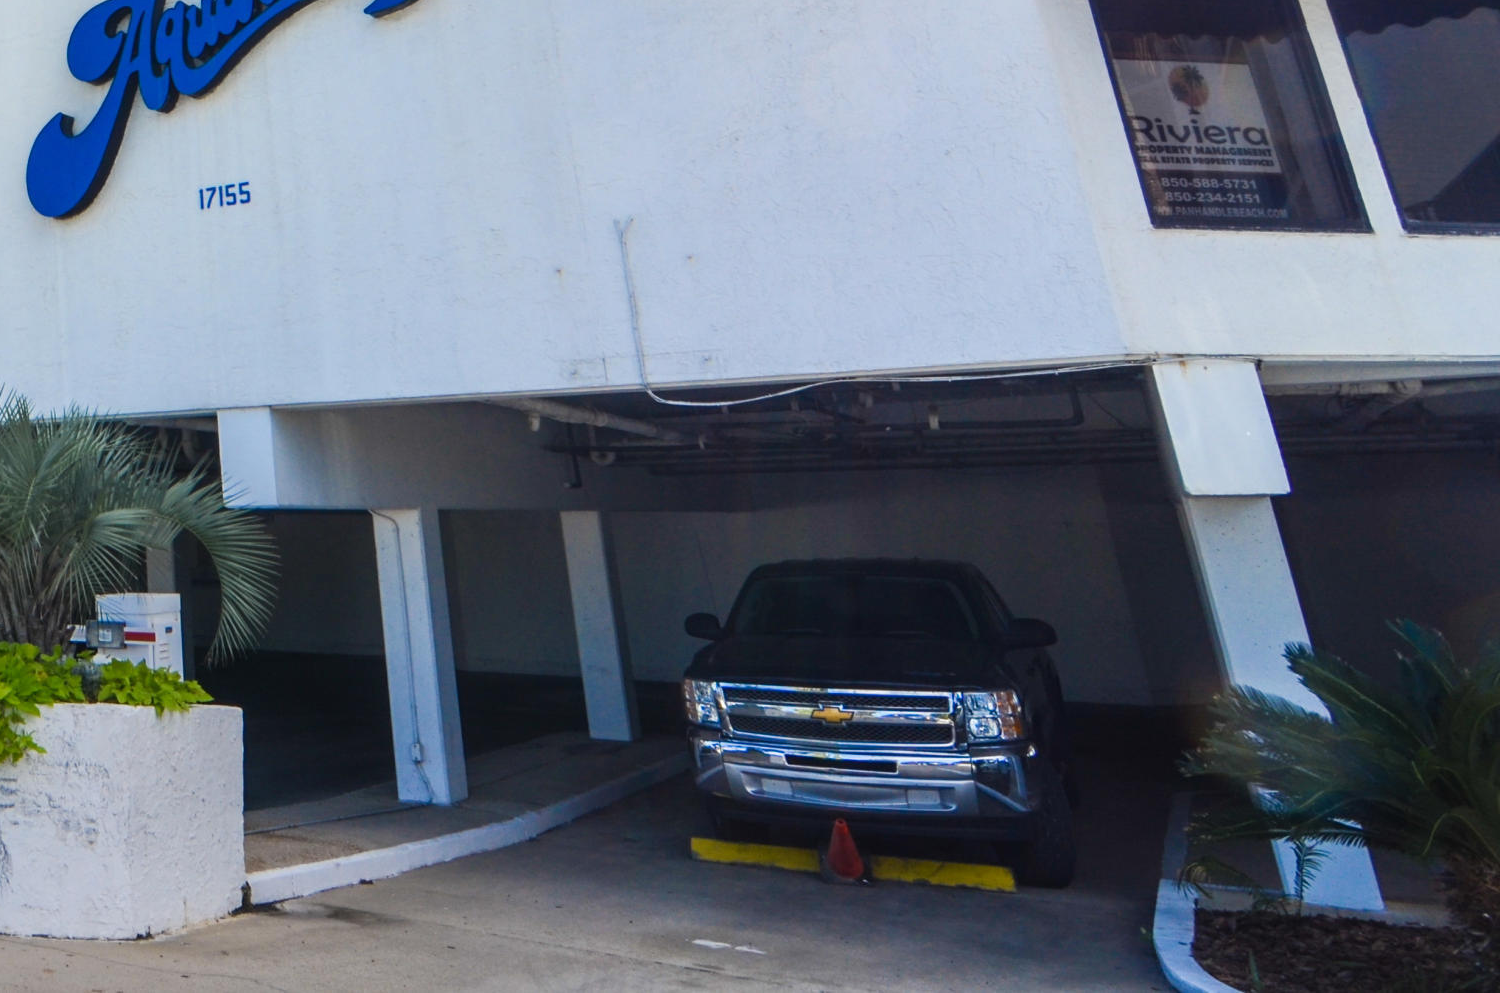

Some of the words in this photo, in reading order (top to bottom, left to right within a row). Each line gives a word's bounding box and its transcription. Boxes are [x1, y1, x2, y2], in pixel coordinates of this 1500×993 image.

[1131, 116, 1269, 146] Riviera
[1195, 147, 1272, 157] MANAGEMENT
[1162, 157, 1191, 165] ESTATE
[1193, 157, 1237, 166] PROPERTY
[1239, 158, 1275, 167] SERVICES
[1161, 177, 1258, 189] 850-588-5731
[199, 181, 251, 210] 17155
[1164, 191, 1261, 204] 850-234-2151
